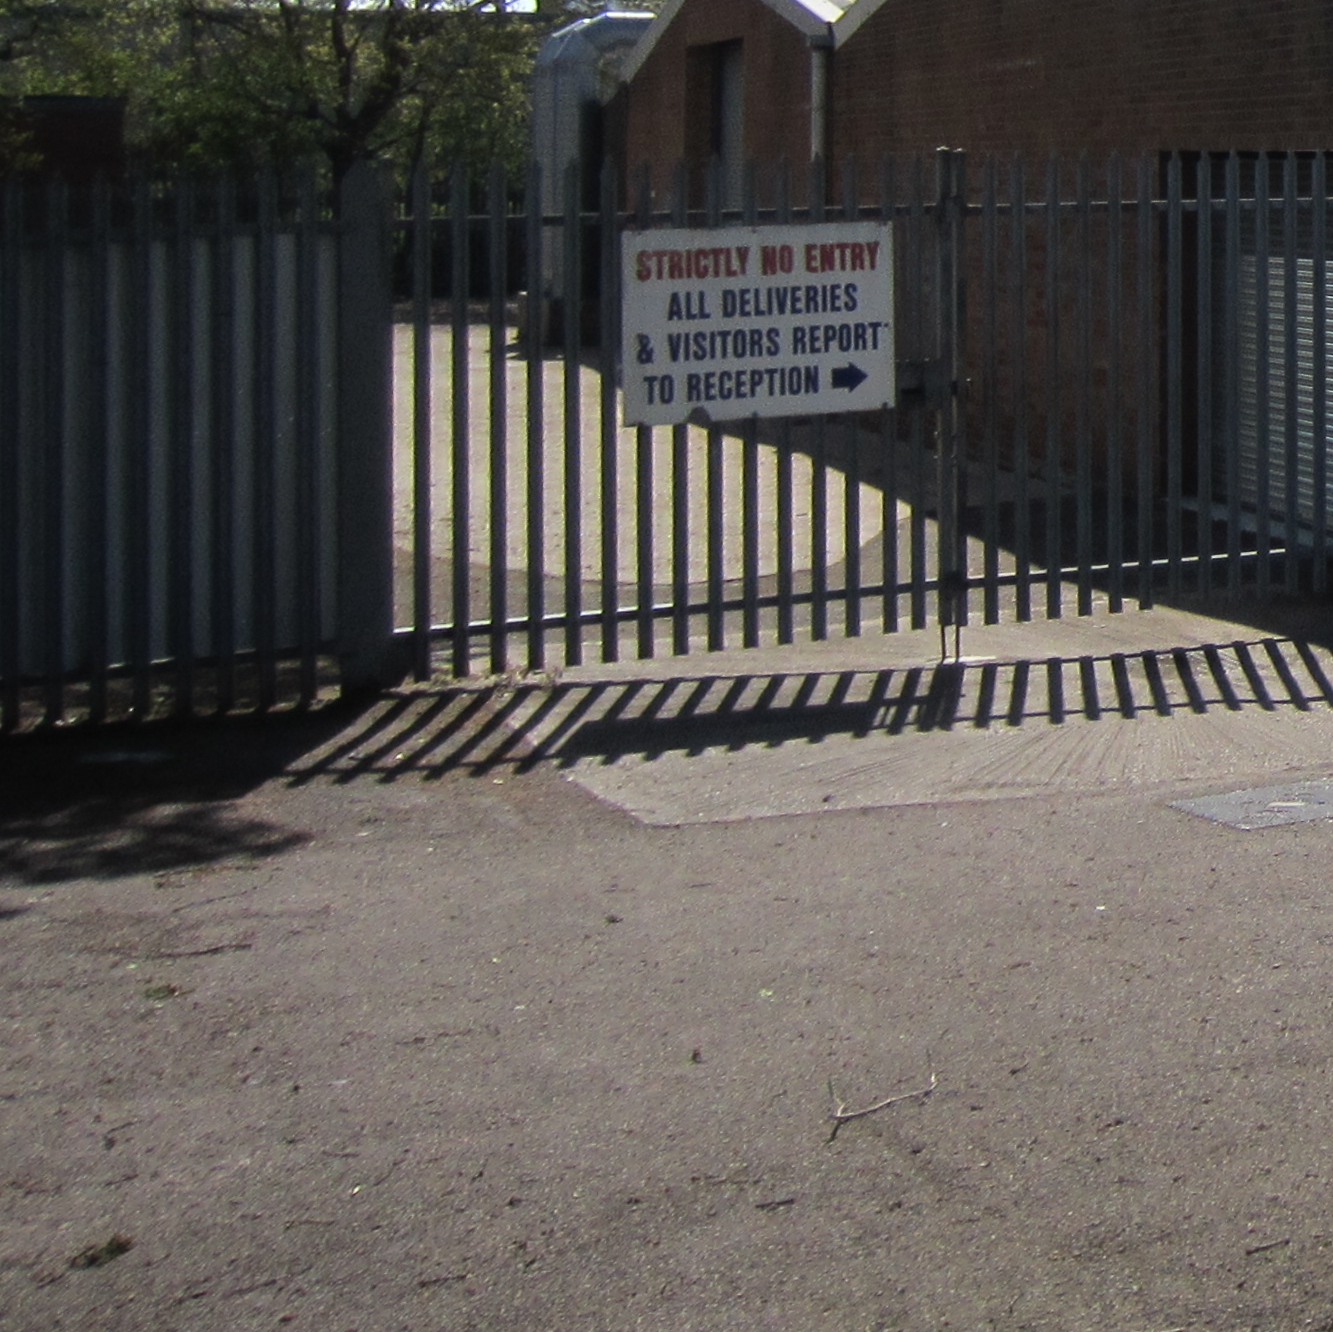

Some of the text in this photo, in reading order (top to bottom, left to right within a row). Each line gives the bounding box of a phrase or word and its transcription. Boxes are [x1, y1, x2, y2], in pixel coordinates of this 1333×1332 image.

[636, 241, 881, 283] STRICTLY NO ENTRY
[667, 283, 858, 321] ALL DELIVERIES
[636, 321, 882, 364] & VISITORS REPORT
[643, 365, 819, 405] TO RECEPTION
